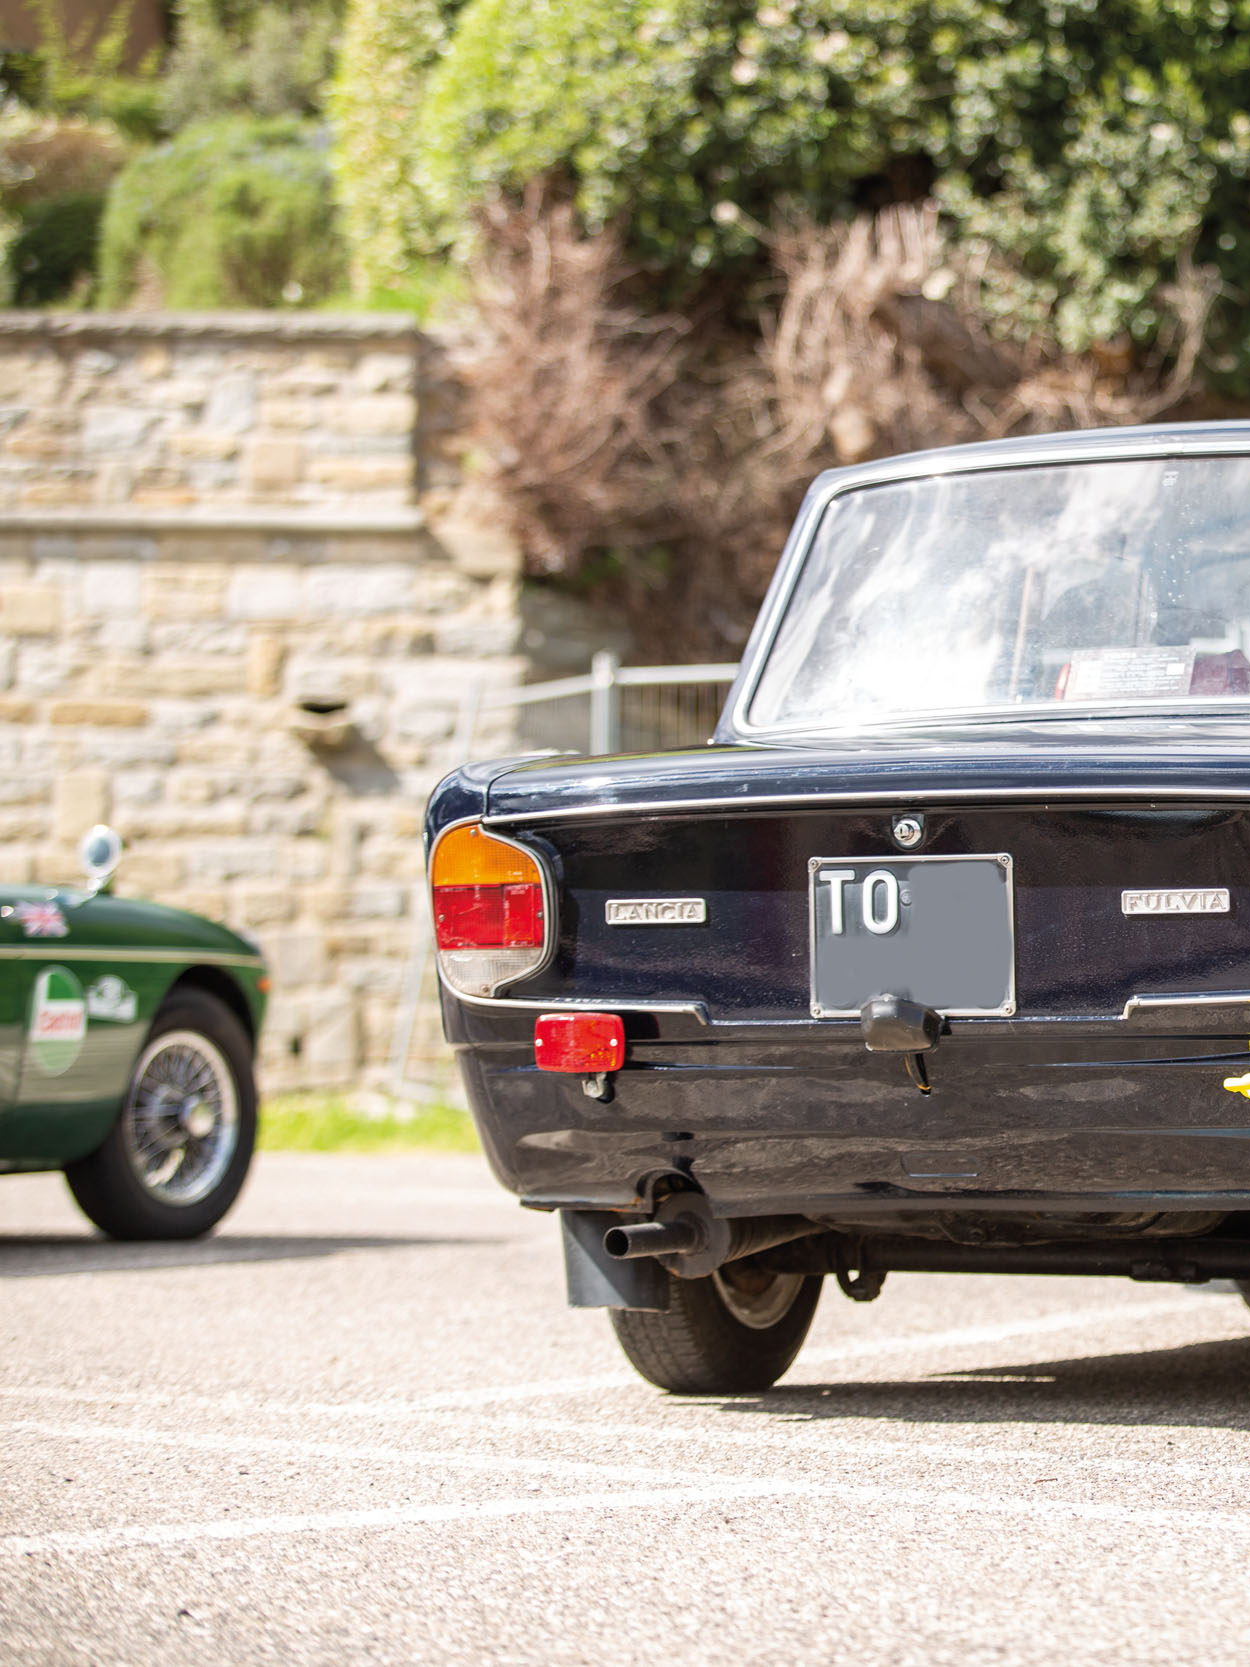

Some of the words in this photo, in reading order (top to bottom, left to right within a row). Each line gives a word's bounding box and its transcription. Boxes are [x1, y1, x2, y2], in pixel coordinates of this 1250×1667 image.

[610, 902, 701, 921] LANCIA
[819, 869, 899, 935] TO
[1126, 893, 1227, 911] FULVIA
